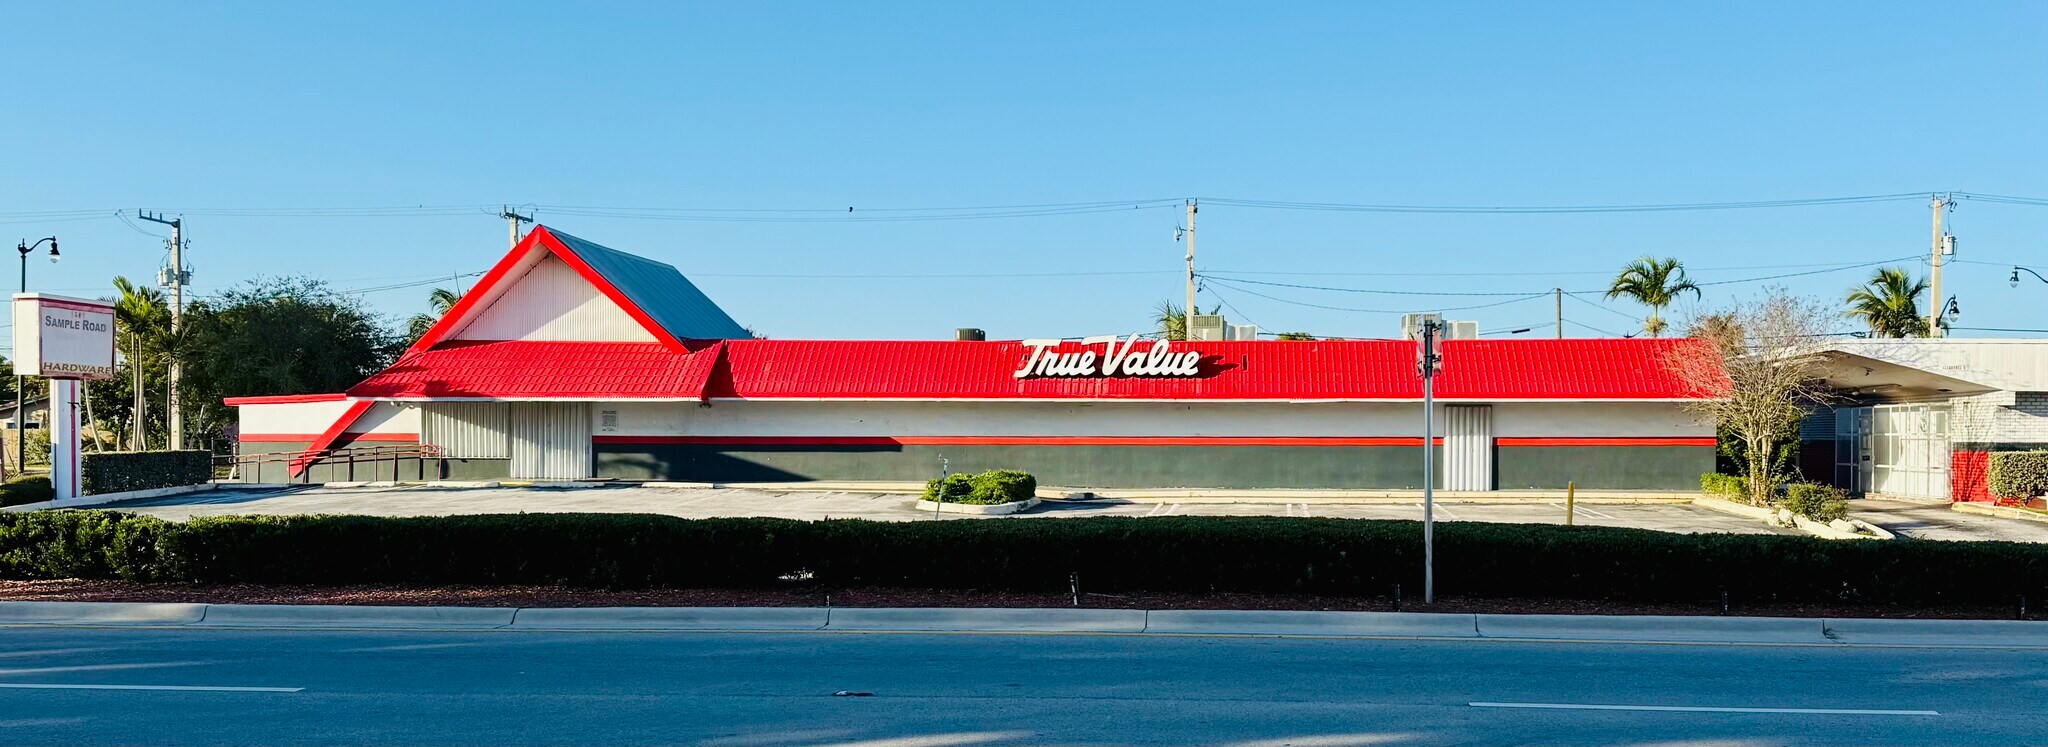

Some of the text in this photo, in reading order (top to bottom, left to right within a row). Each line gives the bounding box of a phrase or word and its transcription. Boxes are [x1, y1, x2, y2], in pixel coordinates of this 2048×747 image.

[45, 315, 107, 332] SAMPLE ROAD
[1013, 331, 1200, 378] True Value
[43, 362, 112, 374] HARDWARE
